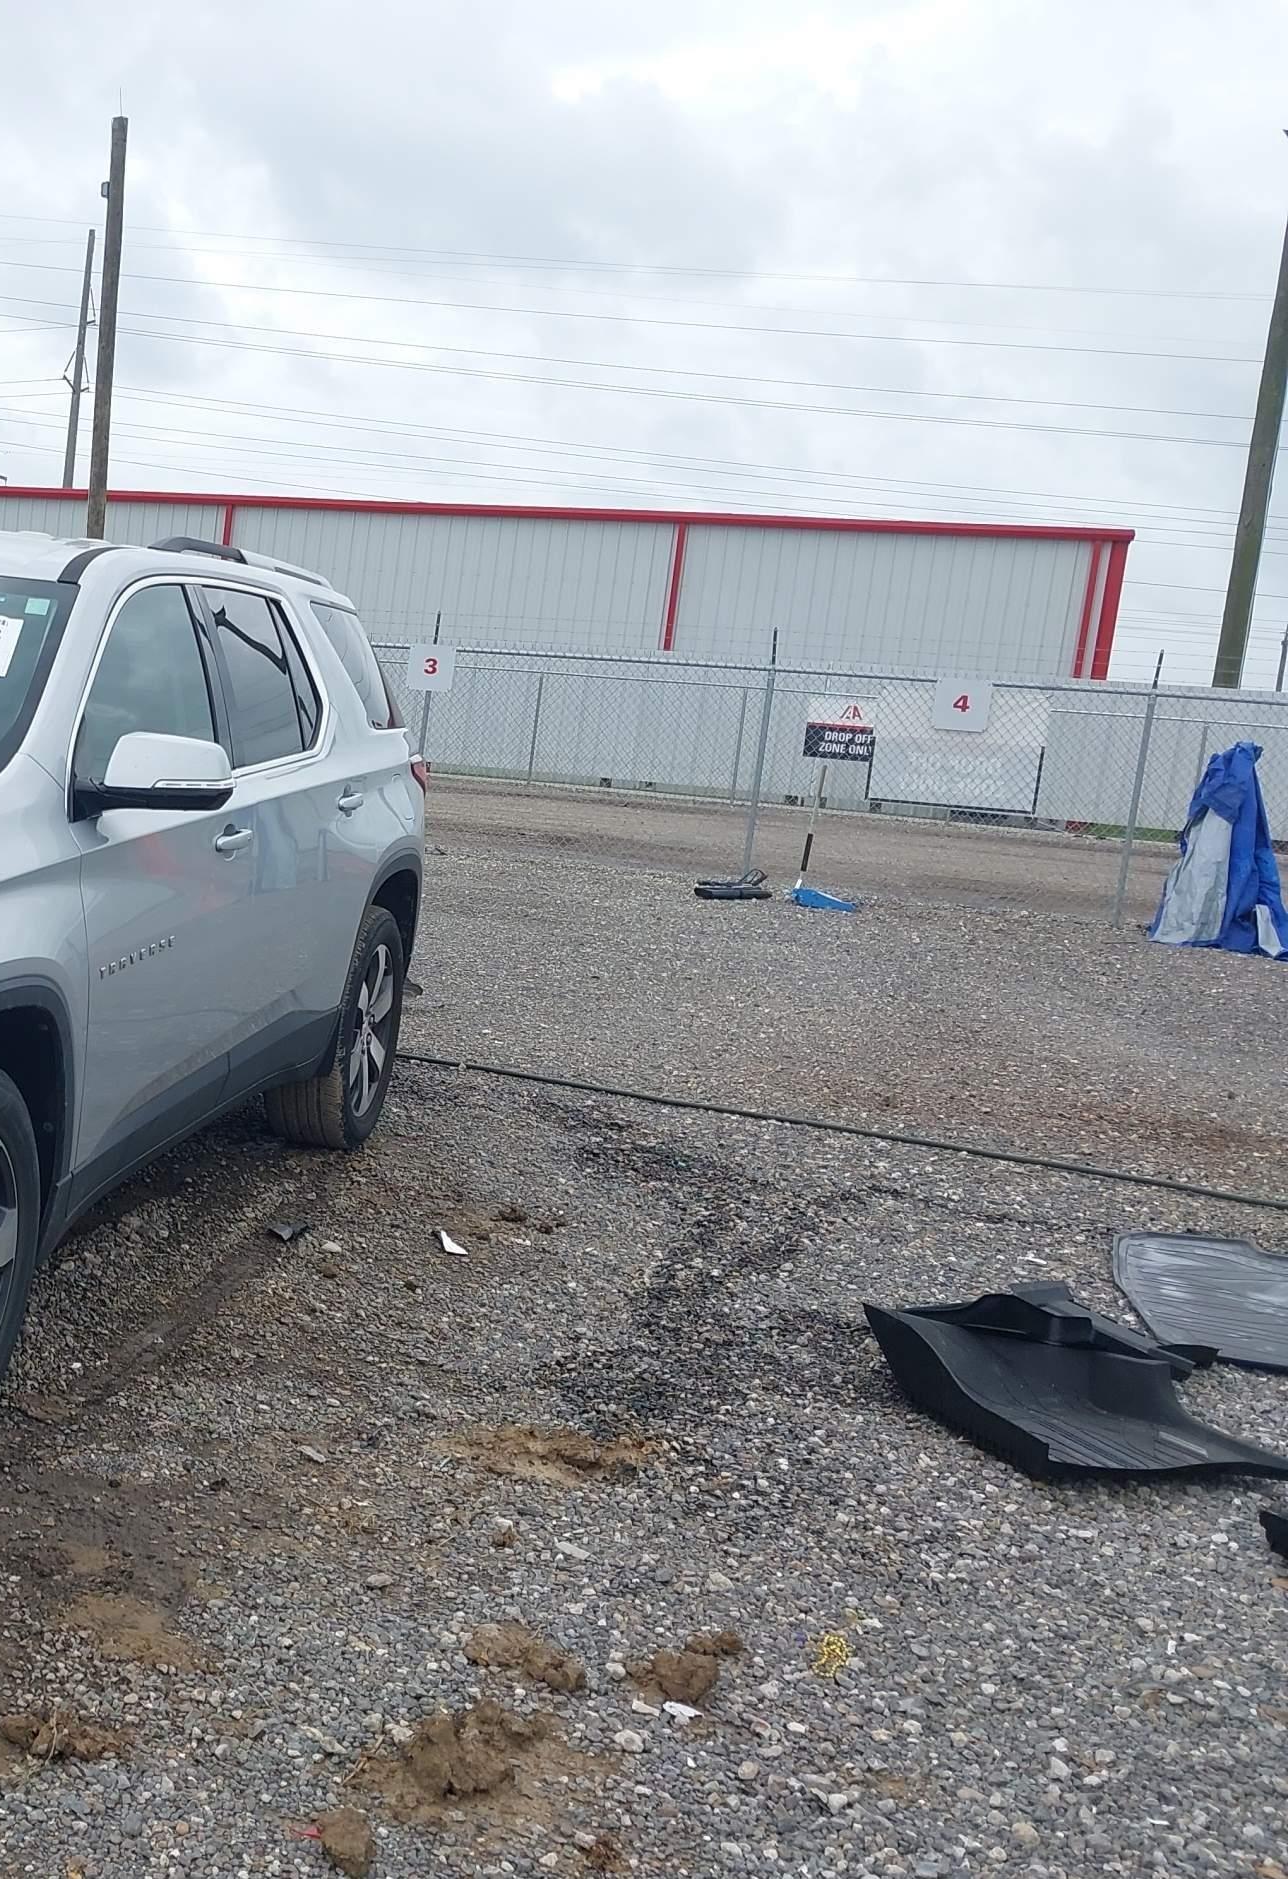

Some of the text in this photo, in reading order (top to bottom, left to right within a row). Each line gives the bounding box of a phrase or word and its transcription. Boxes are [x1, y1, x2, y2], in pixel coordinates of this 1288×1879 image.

[424, 658, 438, 675] 3
[953, 695, 970, 712] 4
[824, 731, 873, 744] DROP OFF
[818, 742, 847, 754] ZONE
